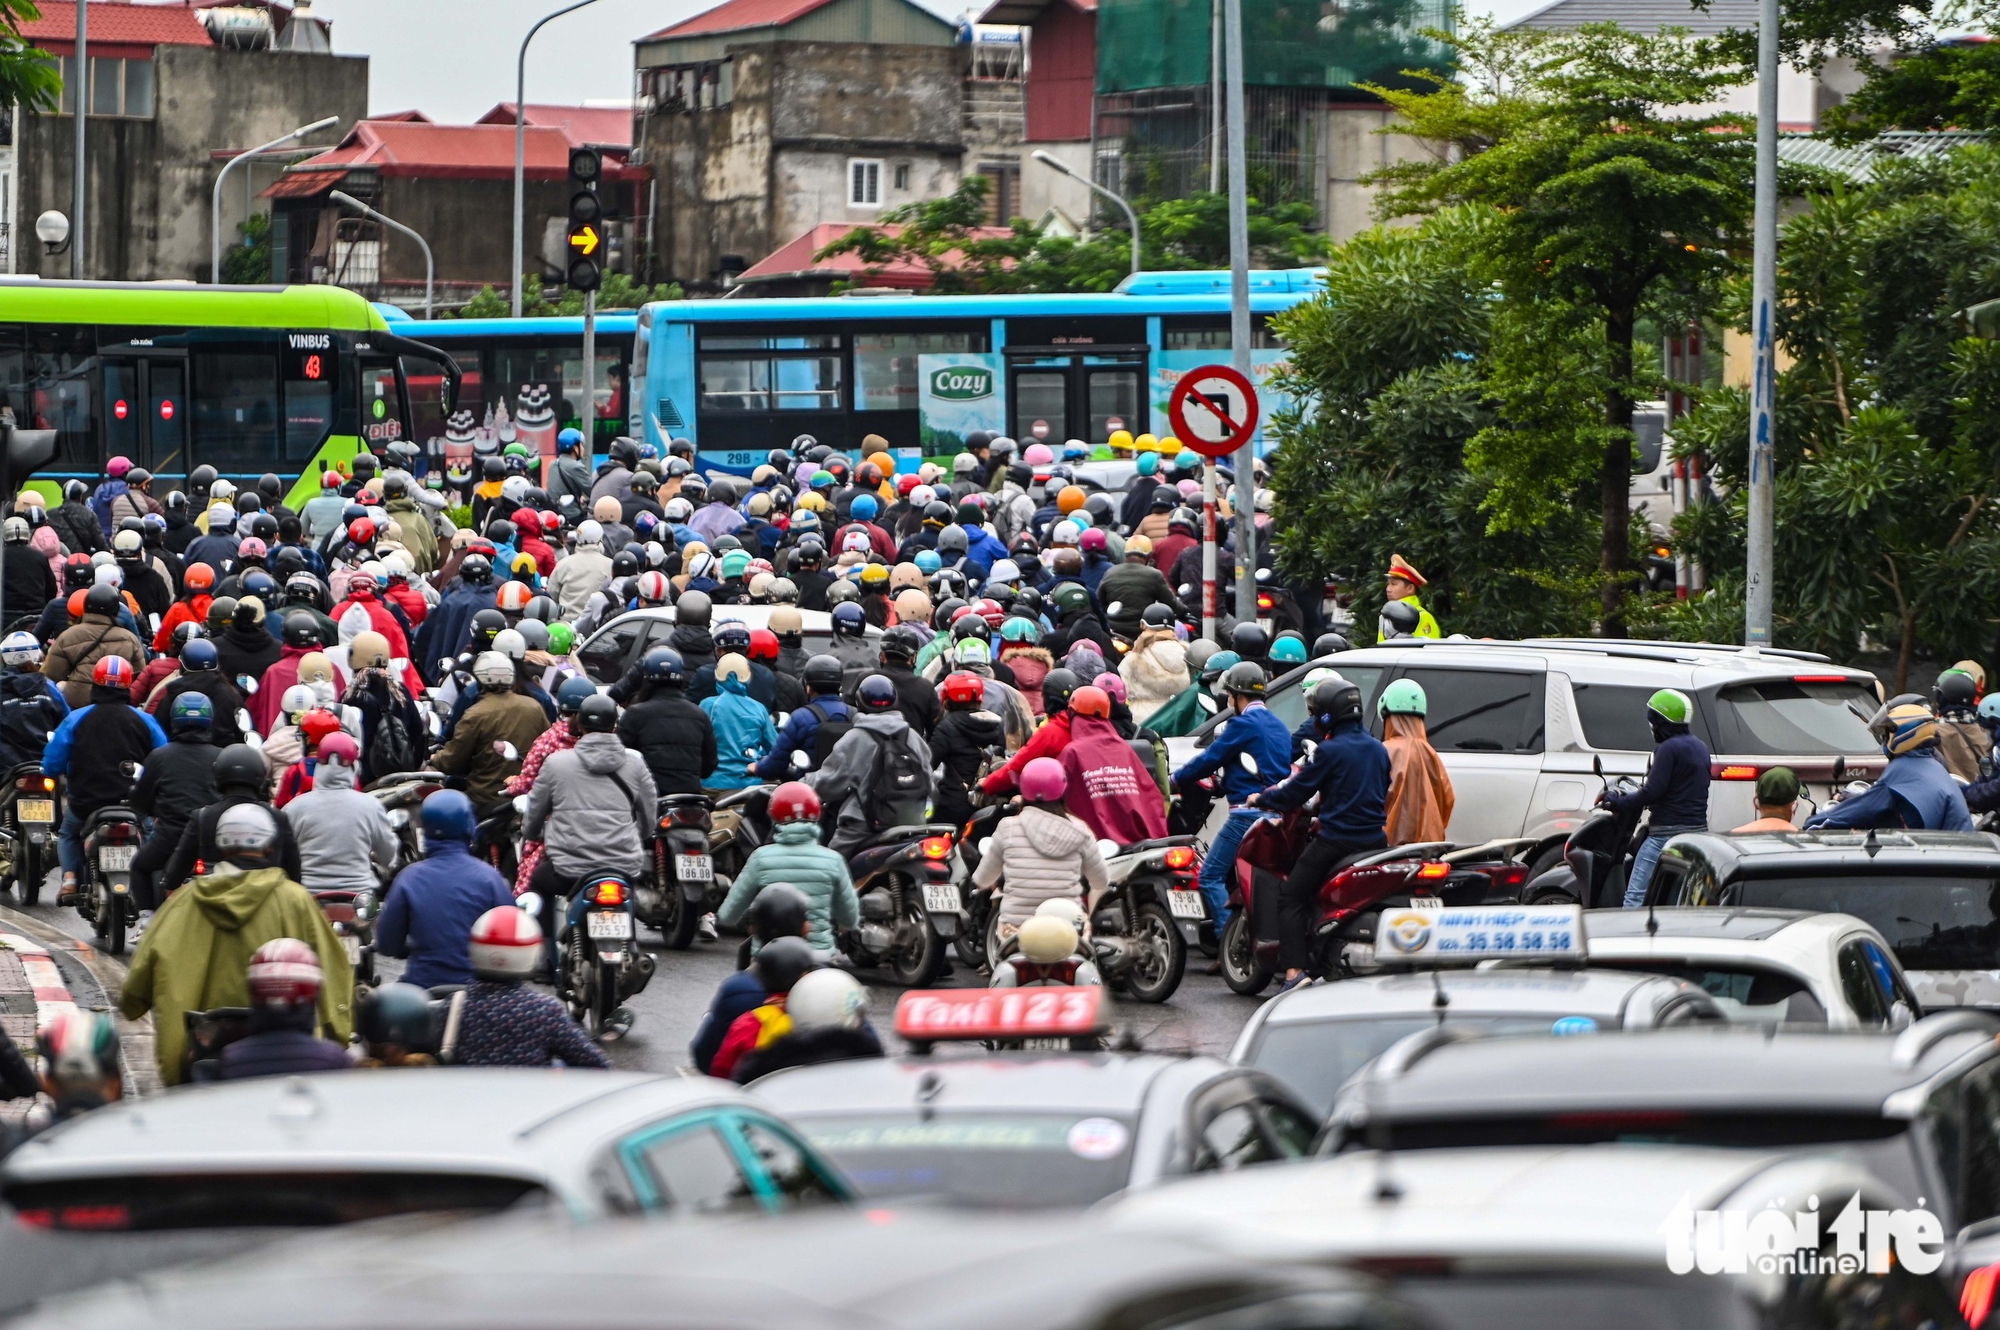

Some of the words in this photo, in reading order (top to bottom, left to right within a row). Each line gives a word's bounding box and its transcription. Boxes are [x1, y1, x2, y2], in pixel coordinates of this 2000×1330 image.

[289, 334, 330, 349] VINBUS
[306, 355, 320, 379] 43
[935, 372, 987, 394] Cozy
[727, 453, 751, 465] 29B
[682, 856, 707, 868] 29-B2
[680, 868, 710, 879] 186.08
[929, 886, 954, 898] 29-K1
[928, 899, 957, 910] 821.87
[594, 914, 622, 924] 29-C1
[904, 995, 994, 1027] Taxi
[1001, 992, 1090, 1027] 123
